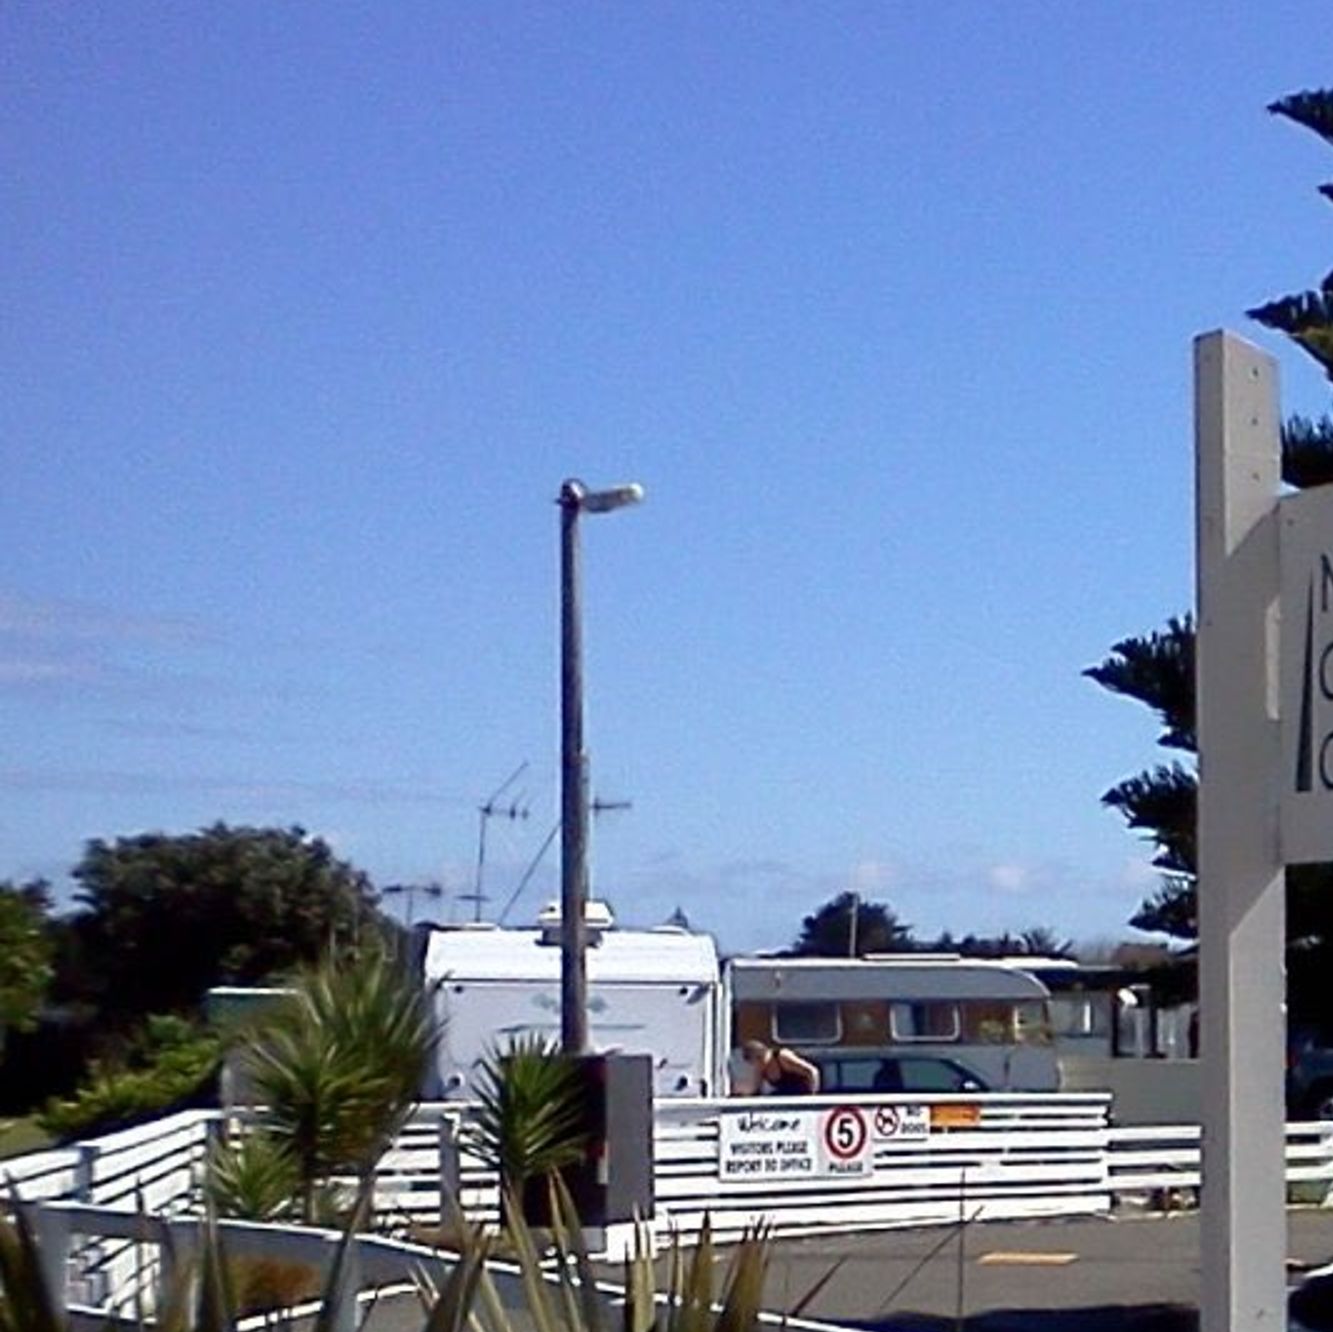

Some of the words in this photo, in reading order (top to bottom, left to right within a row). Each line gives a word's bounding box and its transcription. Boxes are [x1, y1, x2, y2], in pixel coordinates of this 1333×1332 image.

[837, 1117, 855, 1149] 5
[776, 1140, 808, 1154] PLEASE
[726, 1159, 762, 1173] REPORT
[828, 1162, 863, 1174] PLEASE
